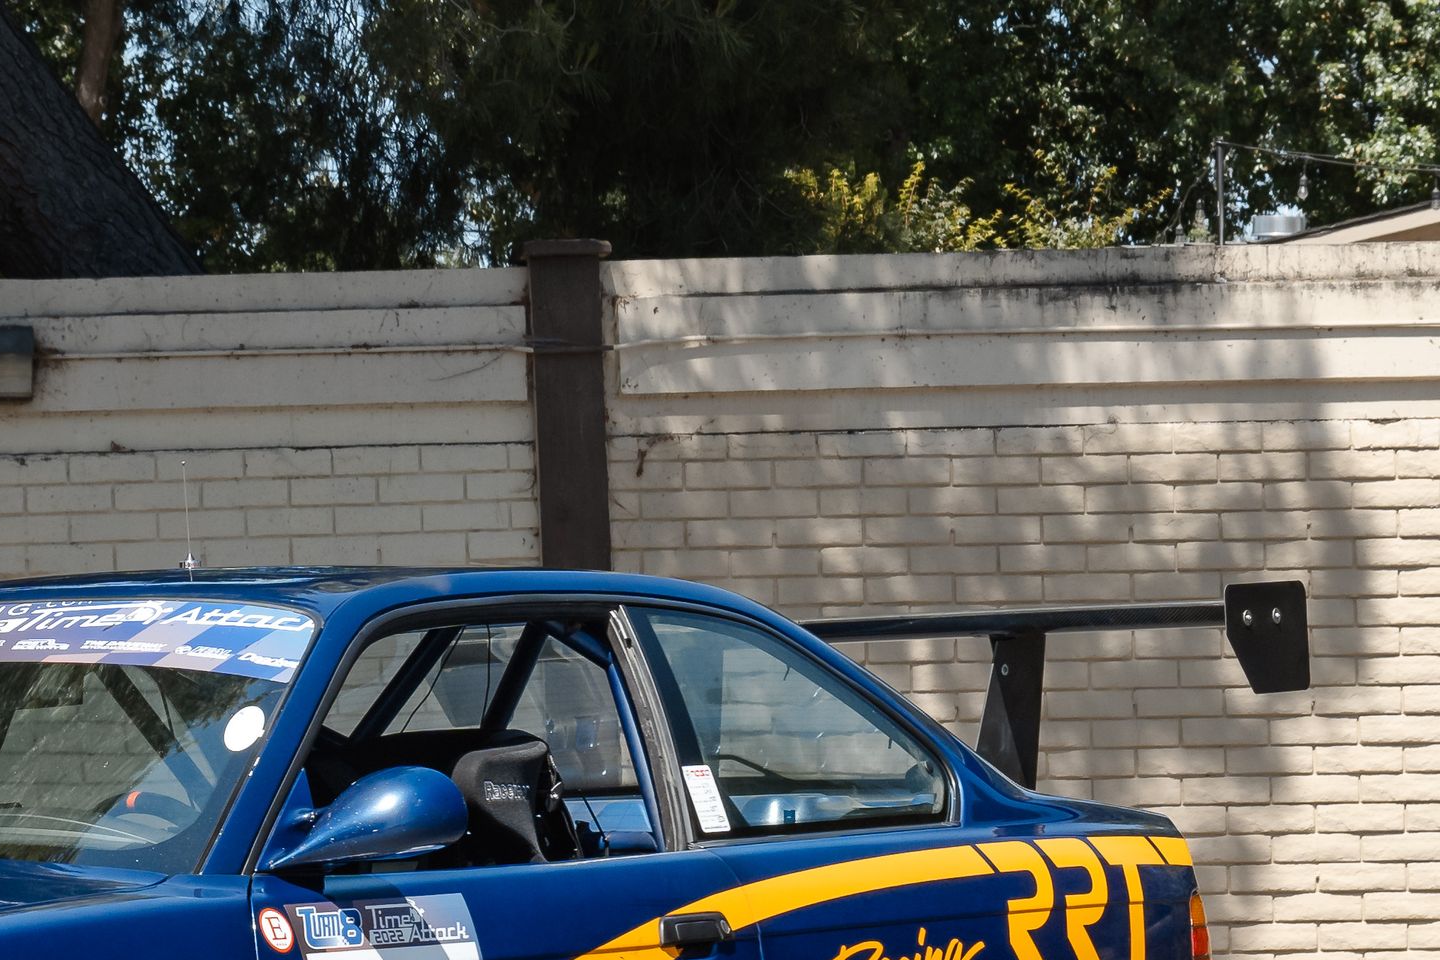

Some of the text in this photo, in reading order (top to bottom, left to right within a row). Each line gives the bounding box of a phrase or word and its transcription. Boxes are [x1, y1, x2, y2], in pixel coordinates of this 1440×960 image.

[18, 602, 130, 632] Time
[265, 916, 287, 941] E
[365, 903, 413, 929] Time
[373, 918, 470, 943] 2022 Attack
